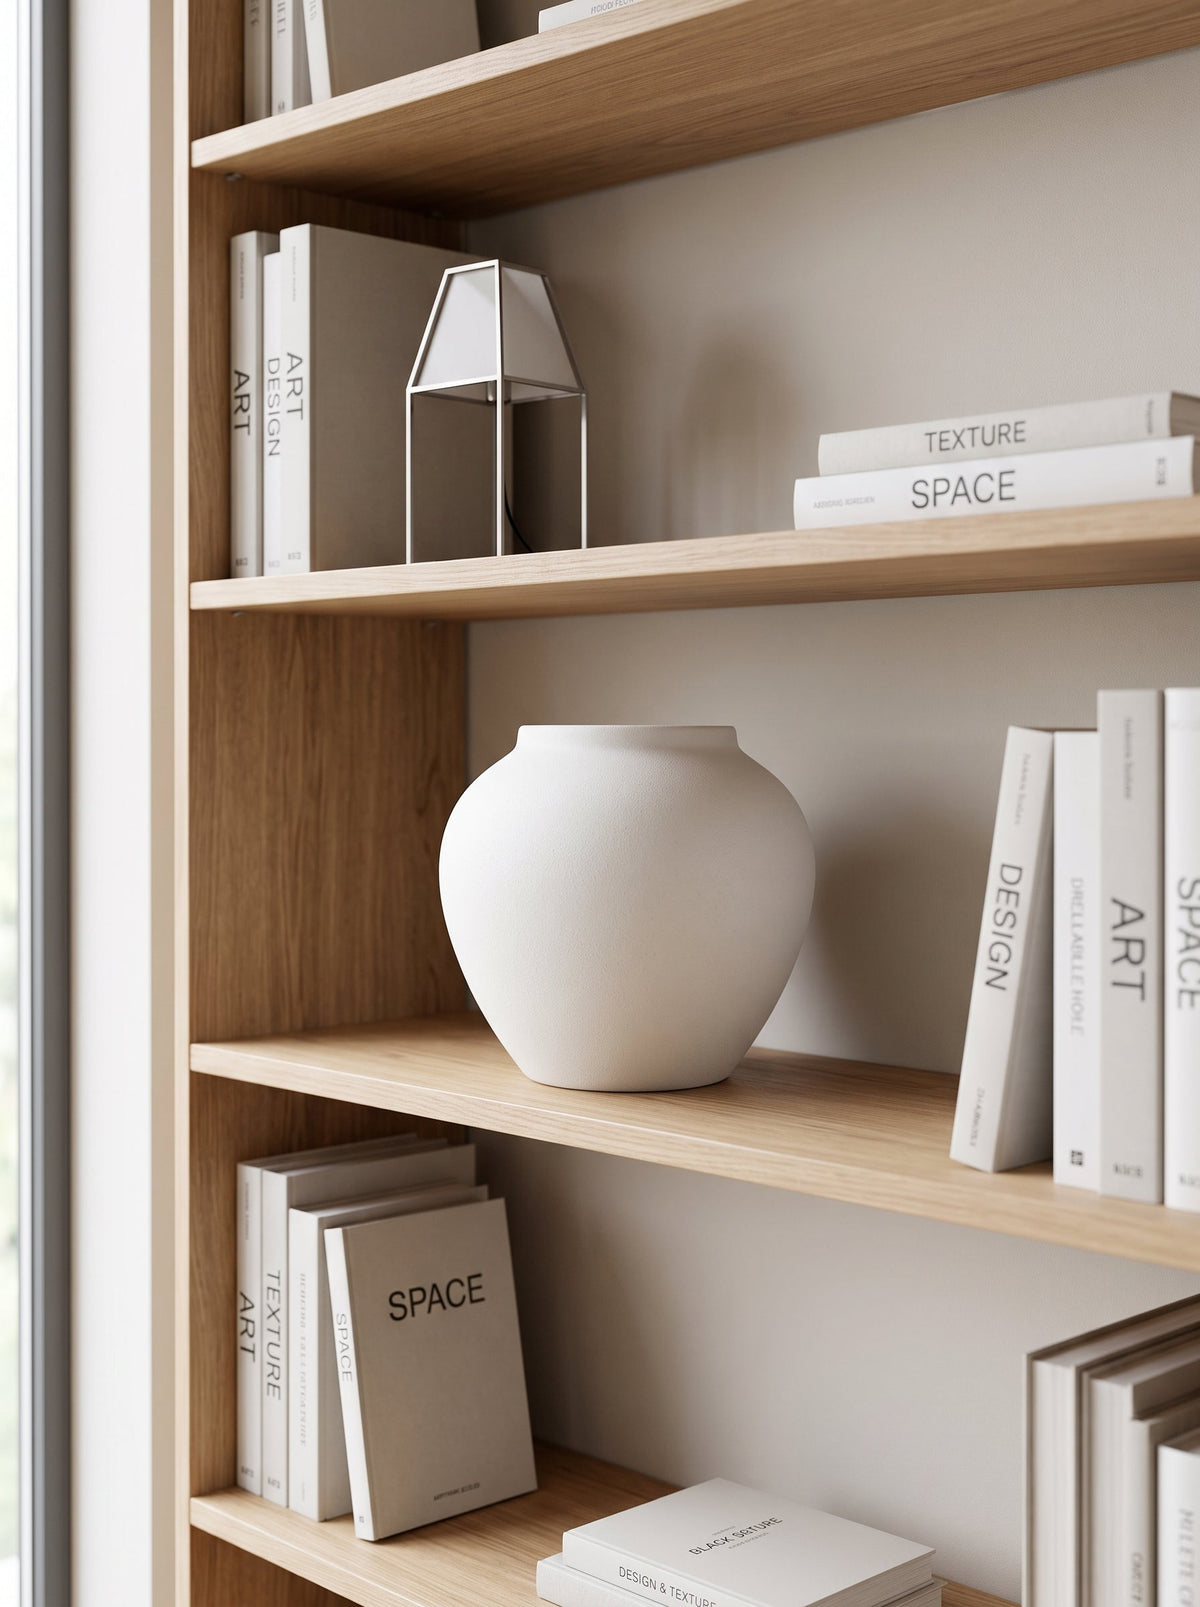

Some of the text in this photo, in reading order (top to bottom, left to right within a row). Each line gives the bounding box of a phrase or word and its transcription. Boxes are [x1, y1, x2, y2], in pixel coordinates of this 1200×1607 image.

[234, 370, 250, 436] ART
[266, 357, 280, 457] DESIGN
[286, 351, 304, 421] ART
[924, 420, 1026, 453] TEXTURE
[911, 470, 1016, 509] SPACE
[985, 862, 1024, 991] DESIGN
[1111, 897, 1146, 1002] ART
[1177, 877, 1200, 1009] SPACE
[238, 1291, 256, 1363] ART
[388, 1272, 486, 1322] SPACE
[265, 1270, 282, 1401] TEXTURE
[335, 1311, 354, 1383] SPACE
[618, 1565, 657, 1591] DESIGN
[659, 1582, 668, 1595] &
